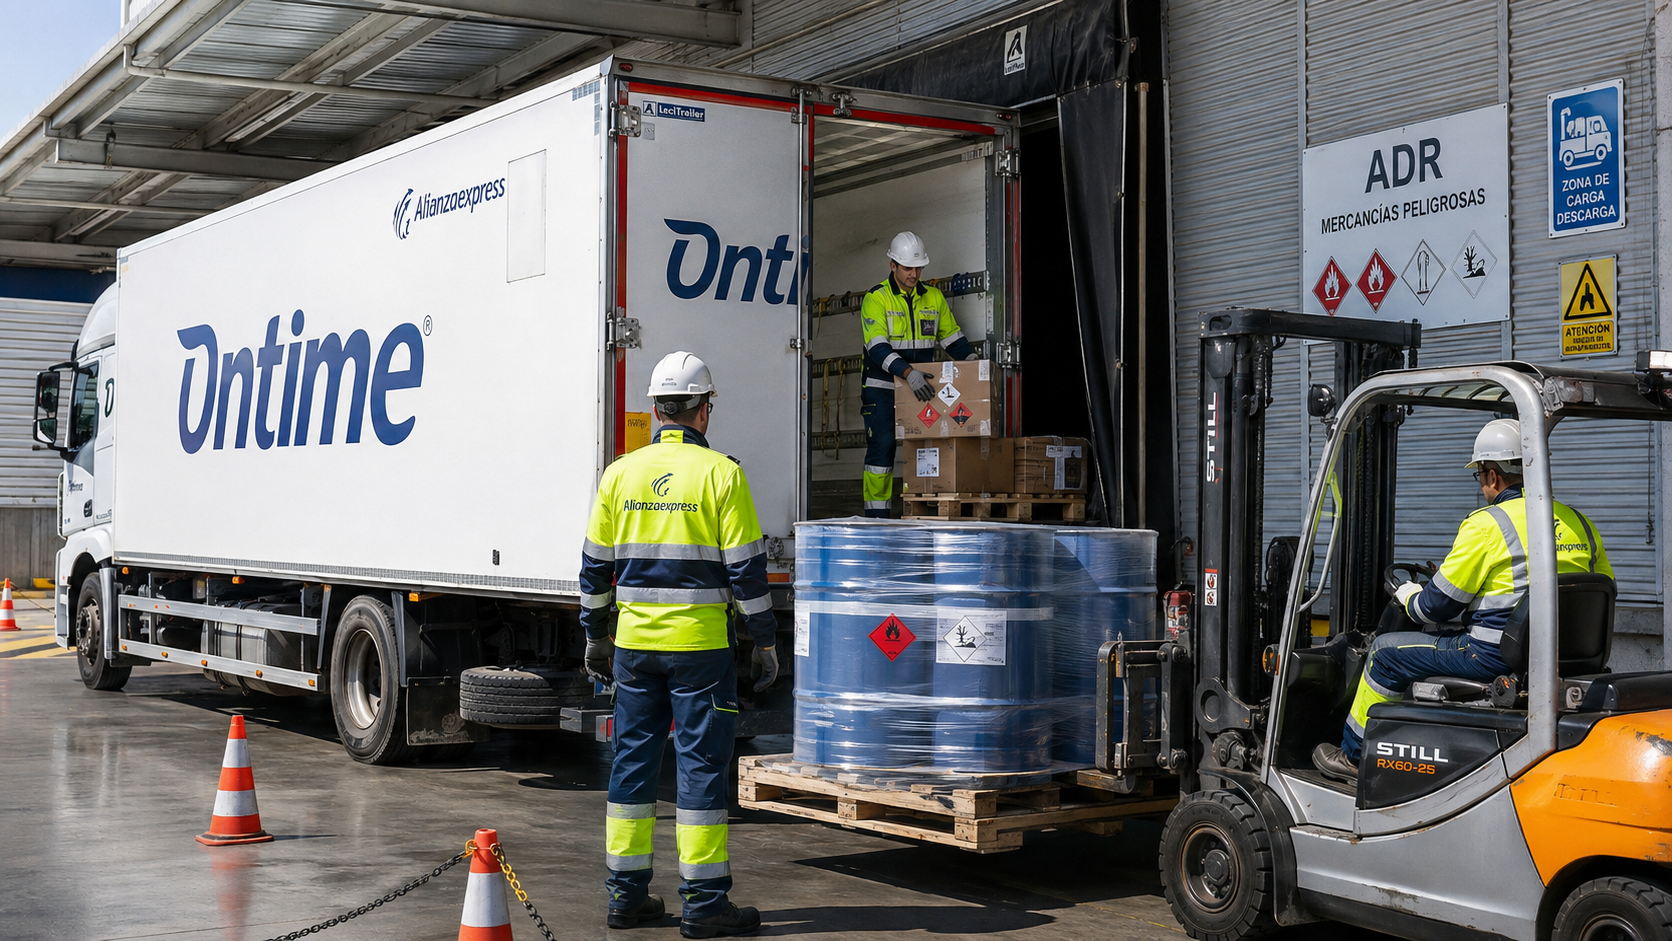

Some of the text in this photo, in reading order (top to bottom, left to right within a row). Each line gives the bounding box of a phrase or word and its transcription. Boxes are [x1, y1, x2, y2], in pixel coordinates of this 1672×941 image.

[1364, 137, 1443, 194] ADR
[1562, 172, 1610, 192] ZONA DE
[413, 177, 506, 222] Alianzaexpress
[1566, 189, 1605, 207] CARGA
[1321, 188, 1486, 235] MERCANCÍAS PELIGROSAS
[1556, 204, 1617, 225] DESCARGA
[1206, 391, 1216, 482] STILL
[623, 499, 699, 514] Alianzaexpress
[1376, 742, 1449, 763] STILL
[1377, 758, 1436, 775] RX60-25
